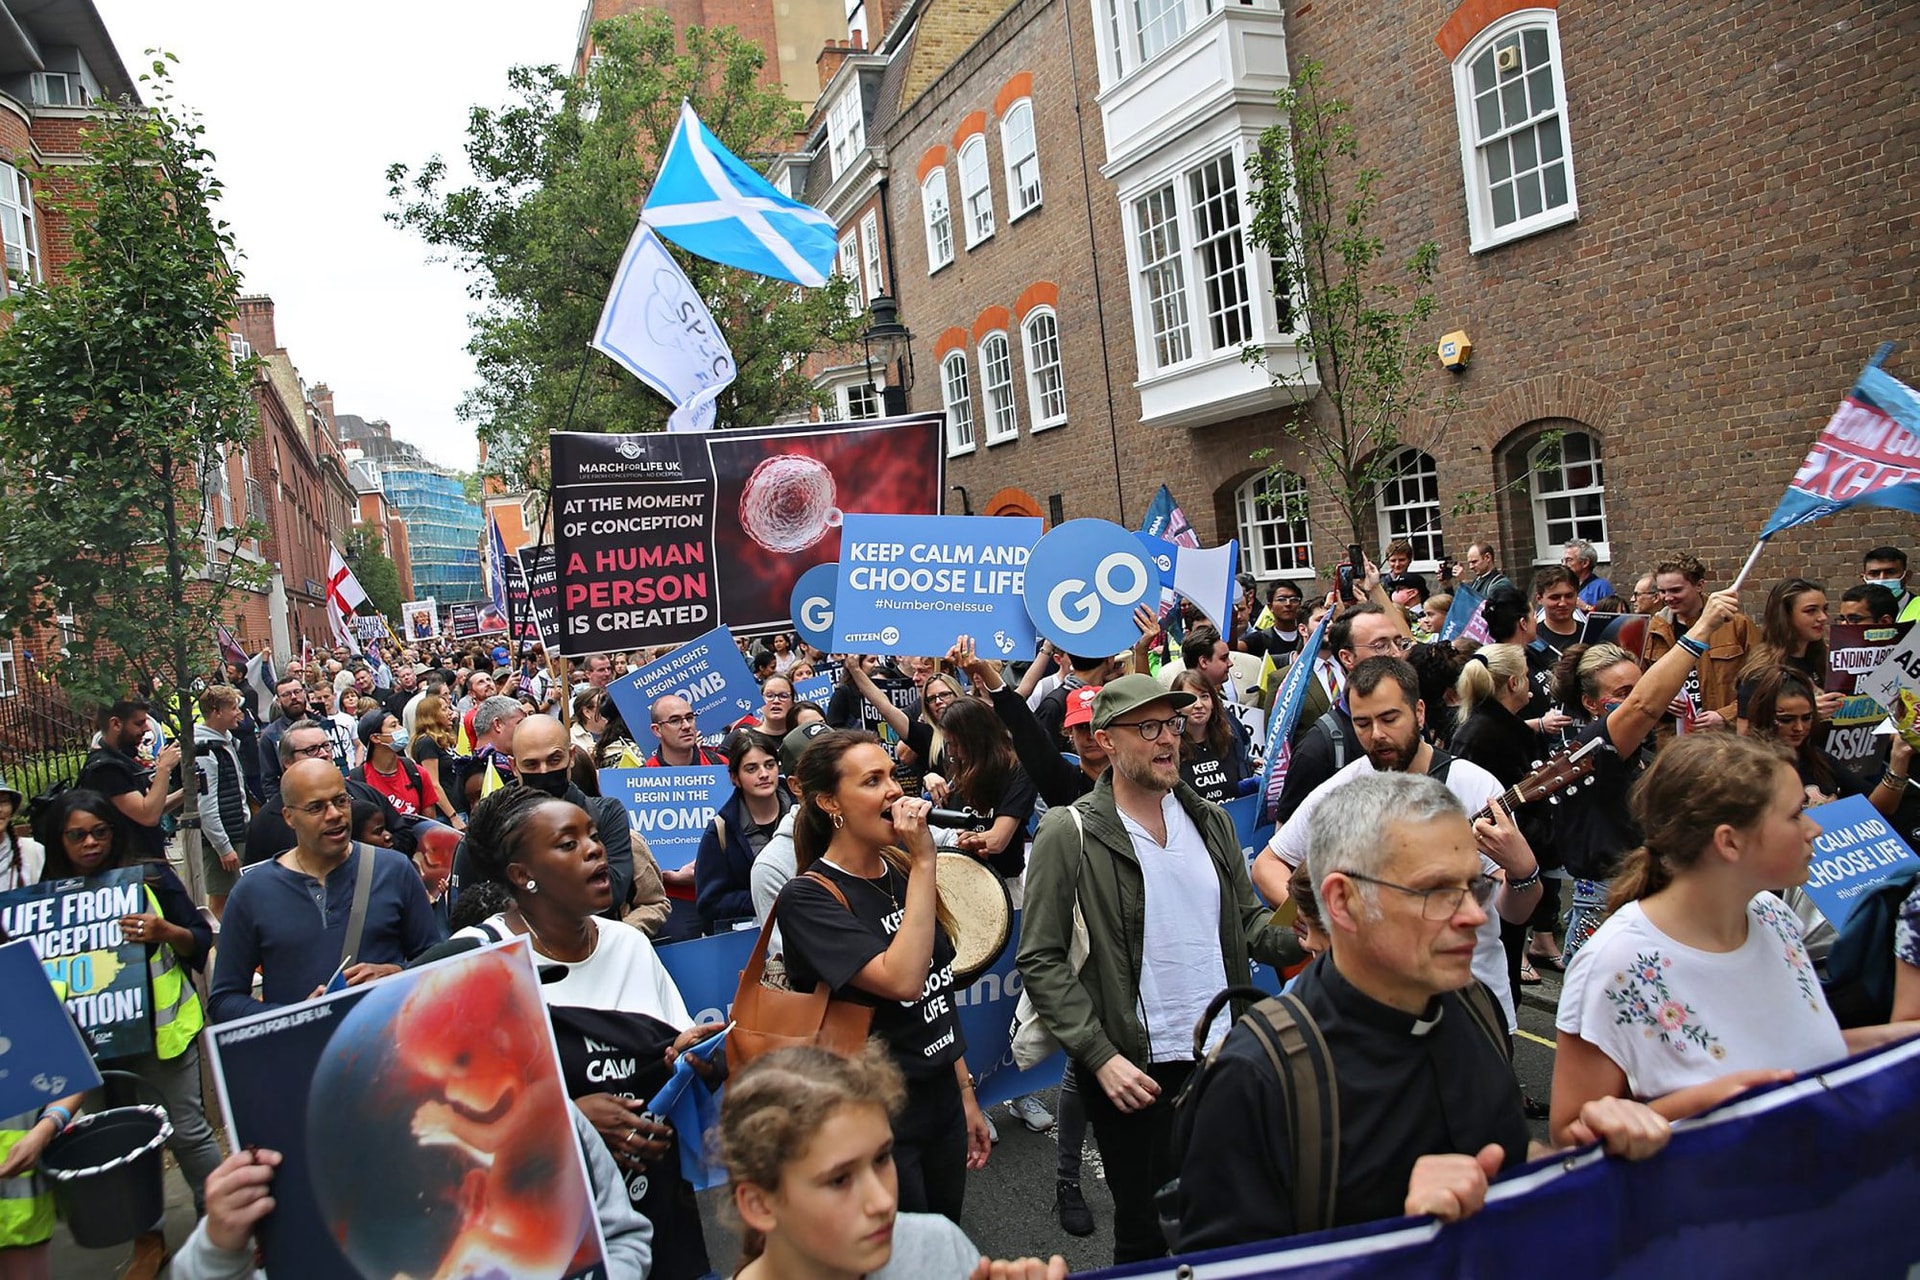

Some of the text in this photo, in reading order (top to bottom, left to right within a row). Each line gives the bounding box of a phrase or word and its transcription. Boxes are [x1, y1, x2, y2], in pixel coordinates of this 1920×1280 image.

[665, 462, 681, 471] UK
[563, 494, 705, 515] AT THE MOMENT
[563, 514, 704, 538] OF CONCEPTION
[565, 541, 705, 576] A HUMAN
[850, 543, 1030, 566] KEEP CALM AND
[565, 572, 708, 611] PERSON
[849, 567, 1024, 595] CHOOSE LIFE
[1047, 552, 1148, 635] GO
[538, 607, 554, 621] MY
[874, 598, 994, 613] #NumberOneIssue
[542, 626, 552, 637] IS
[568, 604, 708, 635] IS CREATED
[633, 644, 709, 690] HUMAN RIGHTS
[1833, 649, 1873, 669] ENDING
[645, 660, 709, 698] BEGIN IN THE
[1282, 661, 1305, 709] MARCH
[808, 686, 829, 700] AND
[1825, 727, 1878, 760] ISSUE
[1192, 760, 1220, 775] KEEP
[1195, 772, 1227, 788] CALM
[626, 774, 716, 789] HUMAN RIGHTS
[1206, 790, 1223, 800] AND
[634, 790, 709, 804] BEGIN IN THE
[1815, 819, 1887, 853] CALM AND
[1866, 838, 1910, 866] LIFE
[1, 882, 138, 938] LIFE FROM
[880, 907, 906, 935] KEE
[33, 918, 130, 960] NCEPTIO
[923, 995, 950, 1024] LIFE
[218, 1004, 333, 1046] MARCH FOR LIFE UK
[586, 1057, 637, 1083] CALM
[631, 1181, 646, 1195] GO
